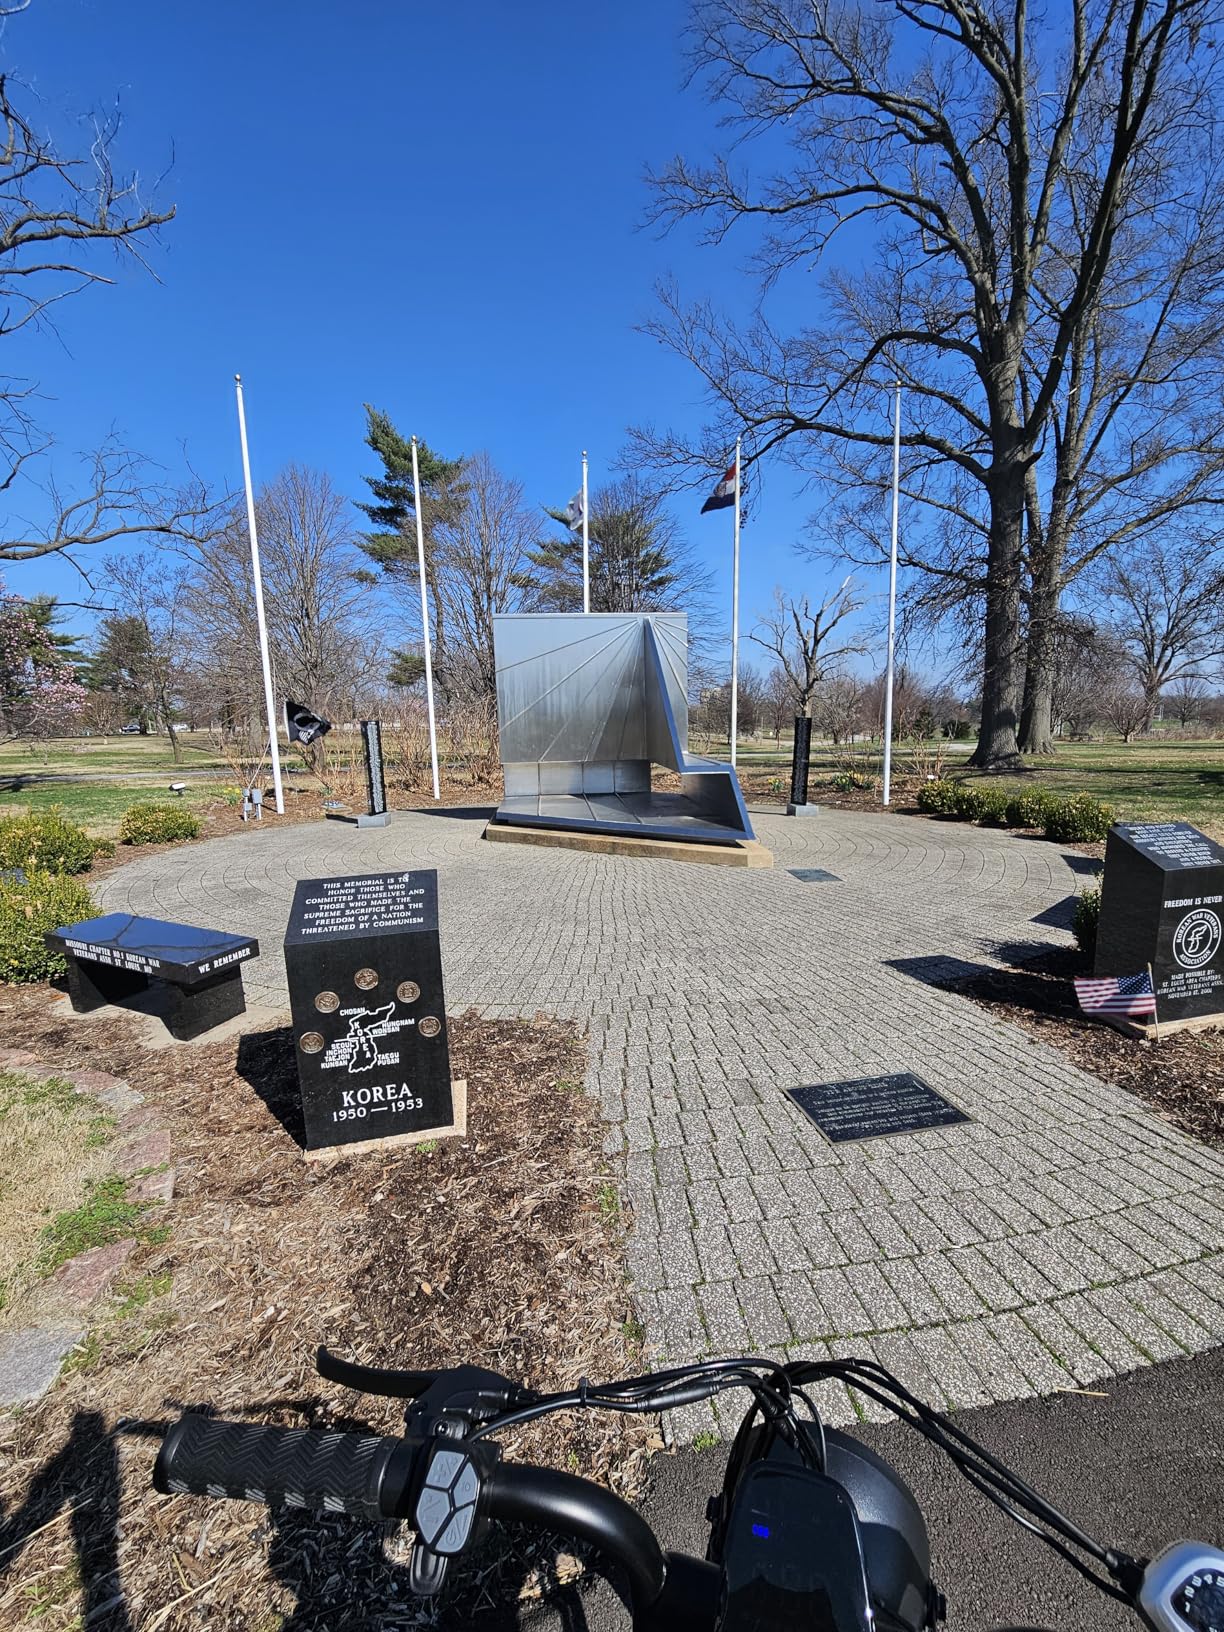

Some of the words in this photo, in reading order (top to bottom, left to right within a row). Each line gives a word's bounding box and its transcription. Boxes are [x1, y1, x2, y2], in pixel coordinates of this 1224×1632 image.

[344, 879, 384, 888] MEMORIAL
[327, 888, 356, 896] HONOR
[359, 885, 385, 893] THOSE
[305, 895, 354, 905] COMMITTED
[356, 890, 406, 900] THEMSELVES
[1163, 898, 1194, 909] FREEDOM
[1194, 897, 1202, 905] IS
[1202, 895, 1223, 904] NEVER
[319, 902, 346, 911] THOSE
[370, 898, 393, 906] MADE
[303, 910, 342, 920] SUPREME
[344, 905, 386, 916] SACRIFICE
[407, 902, 424, 910] THE
[315, 916, 355, 926] FREEDOM
[381, 911, 411, 920] NATION
[301, 923, 356, 935] THREATENED
[373, 917, 424, 928] COMMUNISM
[147, 958, 161, 968] WAR
[198, 962, 211, 974] WE
[213, 947, 251, 969] REMEMBER
[339, 1007, 366, 1016] CHOSAN
[381, 1018, 415, 1028] HUNGNAM
[371, 1026, 400, 1035] WONSAN
[354, 1021, 371, 1058] KOREA
[325, 1047, 353, 1057] INCHON
[331, 1042, 355, 1051] SEOUL
[323, 1053, 351, 1063] TAEJON
[376, 1052, 400, 1060] TAEGU
[320, 1060, 348, 1069] KUNSAN
[376, 1058, 400, 1067] PUSAN
[341, 1082, 413, 1107] KOREA
[1191, 1575, 1203, 1587] 3
[1203, 1573, 1213, 1584] 4
[1184, 1585, 1195, 1598] 2
[1184, 1601, 1191, 1613] 1
